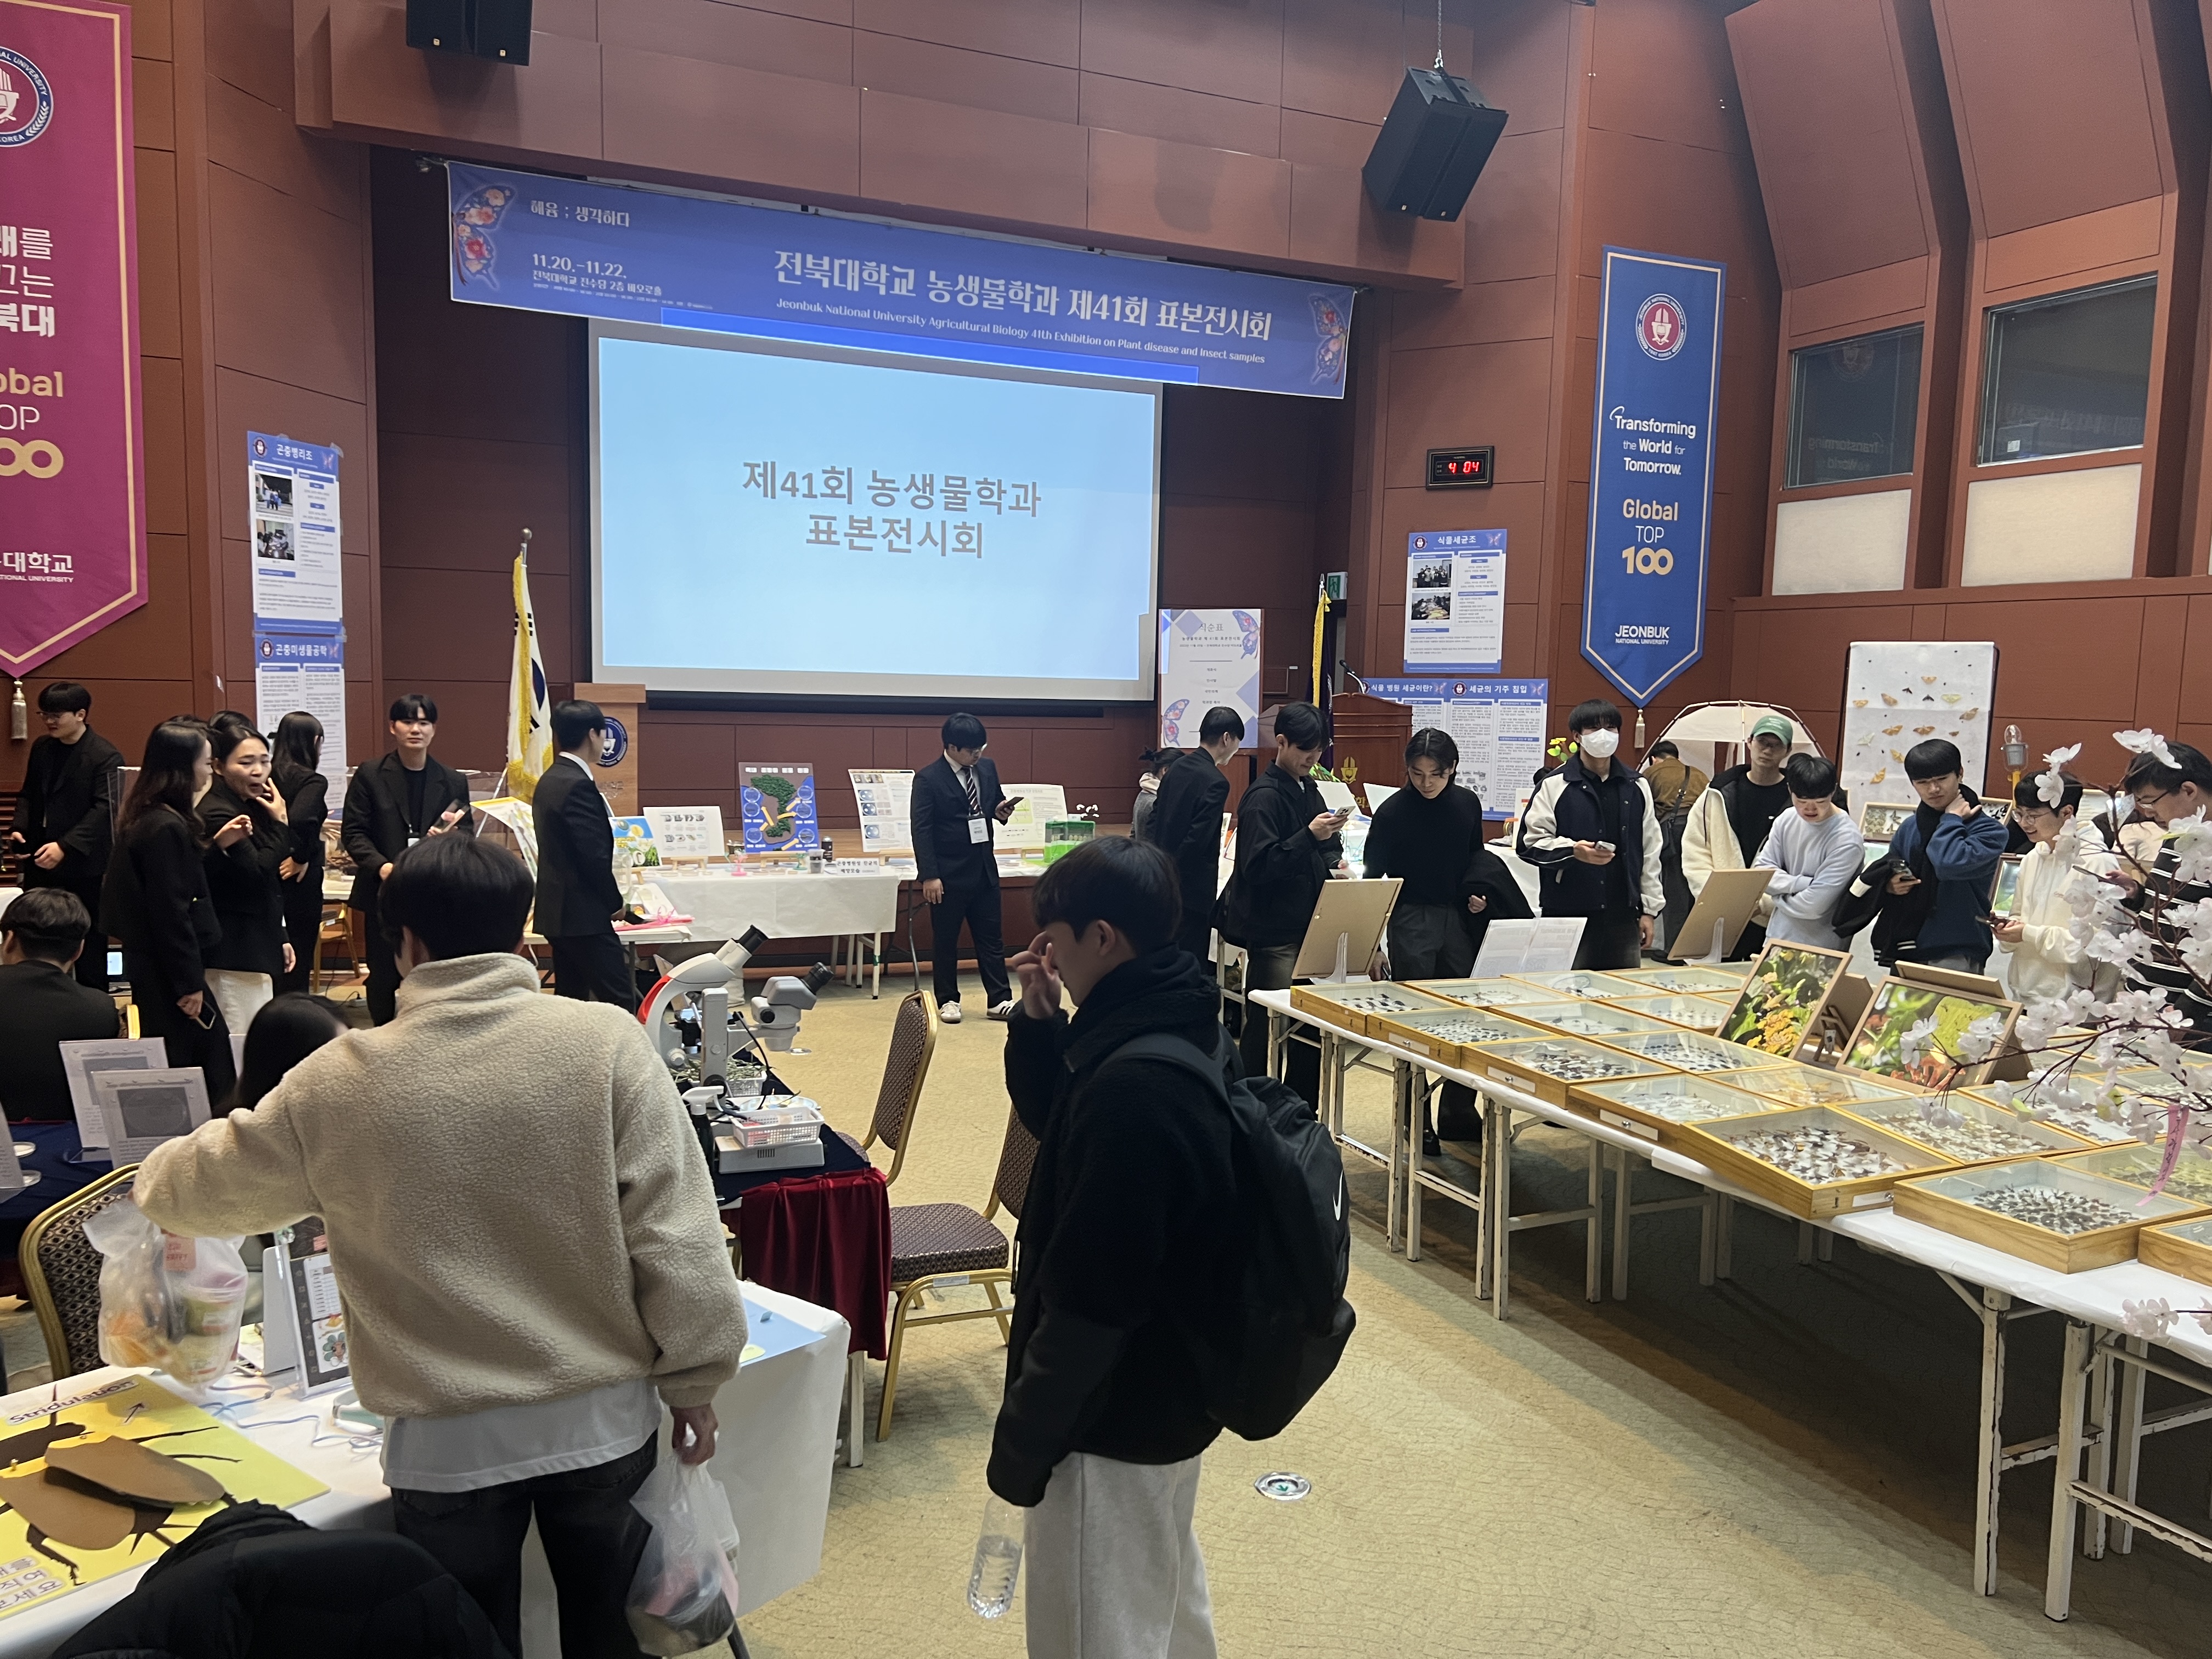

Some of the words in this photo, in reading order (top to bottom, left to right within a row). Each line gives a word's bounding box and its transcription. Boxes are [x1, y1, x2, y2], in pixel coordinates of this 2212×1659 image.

[13, 57, 48, 95] UNIVERSITY
[575, 206, 630, 227] 생각하다
[533, 269, 577, 285] 전북대학교
[610, 280, 624, 291] 2층
[774, 250, 916, 297] 전북대학교
[927, 270, 1059, 316] 농생물학과
[1068, 288, 1148, 326] 제41회
[1155, 300, 1272, 341] 표본전시회
[777, 298, 823, 313] Jeonbuk
[825, 304, 870, 319] National
[873, 311, 926, 327] University
[929, 317, 990, 333] Agricultural
[992, 324, 1029, 339] Biology
[1031, 329, 1052, 340] 41th
[1054, 331, 1101, 346] Exhibition
[1103, 338, 1115, 347] on
[1118, 339, 1142, 351] Plant
[1144, 342, 1179, 354] disease
[1181, 346, 1198, 357] and
[1229, 352, 1265, 364] samples
[1614, 415, 1696, 439] Transforming
[1623, 440, 1637, 450] the
[1639, 439, 1672, 454] World
[1674, 445, 1685, 455] for
[1448, 462, 1457, 475] 4
[1463, 461, 1480, 474] 04
[1623, 457, 1681, 475] Tomorrow.
[742, 461, 853, 505] 제41회
[867, 470, 1041, 517] 농생물학과
[1623, 499, 1678, 521] Global
[806, 514, 983, 558] 표본전시회
[1437, 535, 1476, 545] 식물세균조
[1635, 526, 1664, 543] TOP
[1622, 546, 1673, 575] 100
[1199, 623, 1224, 633] 식순표
[1615, 625, 1670, 639] JEONBUK
[1469, 685, 1492, 693] 세균의
[1494, 685, 1509, 693] 기주
[1513, 685, 1527, 694] 침입
[9, 1380, 136, 1423] Stridulation
